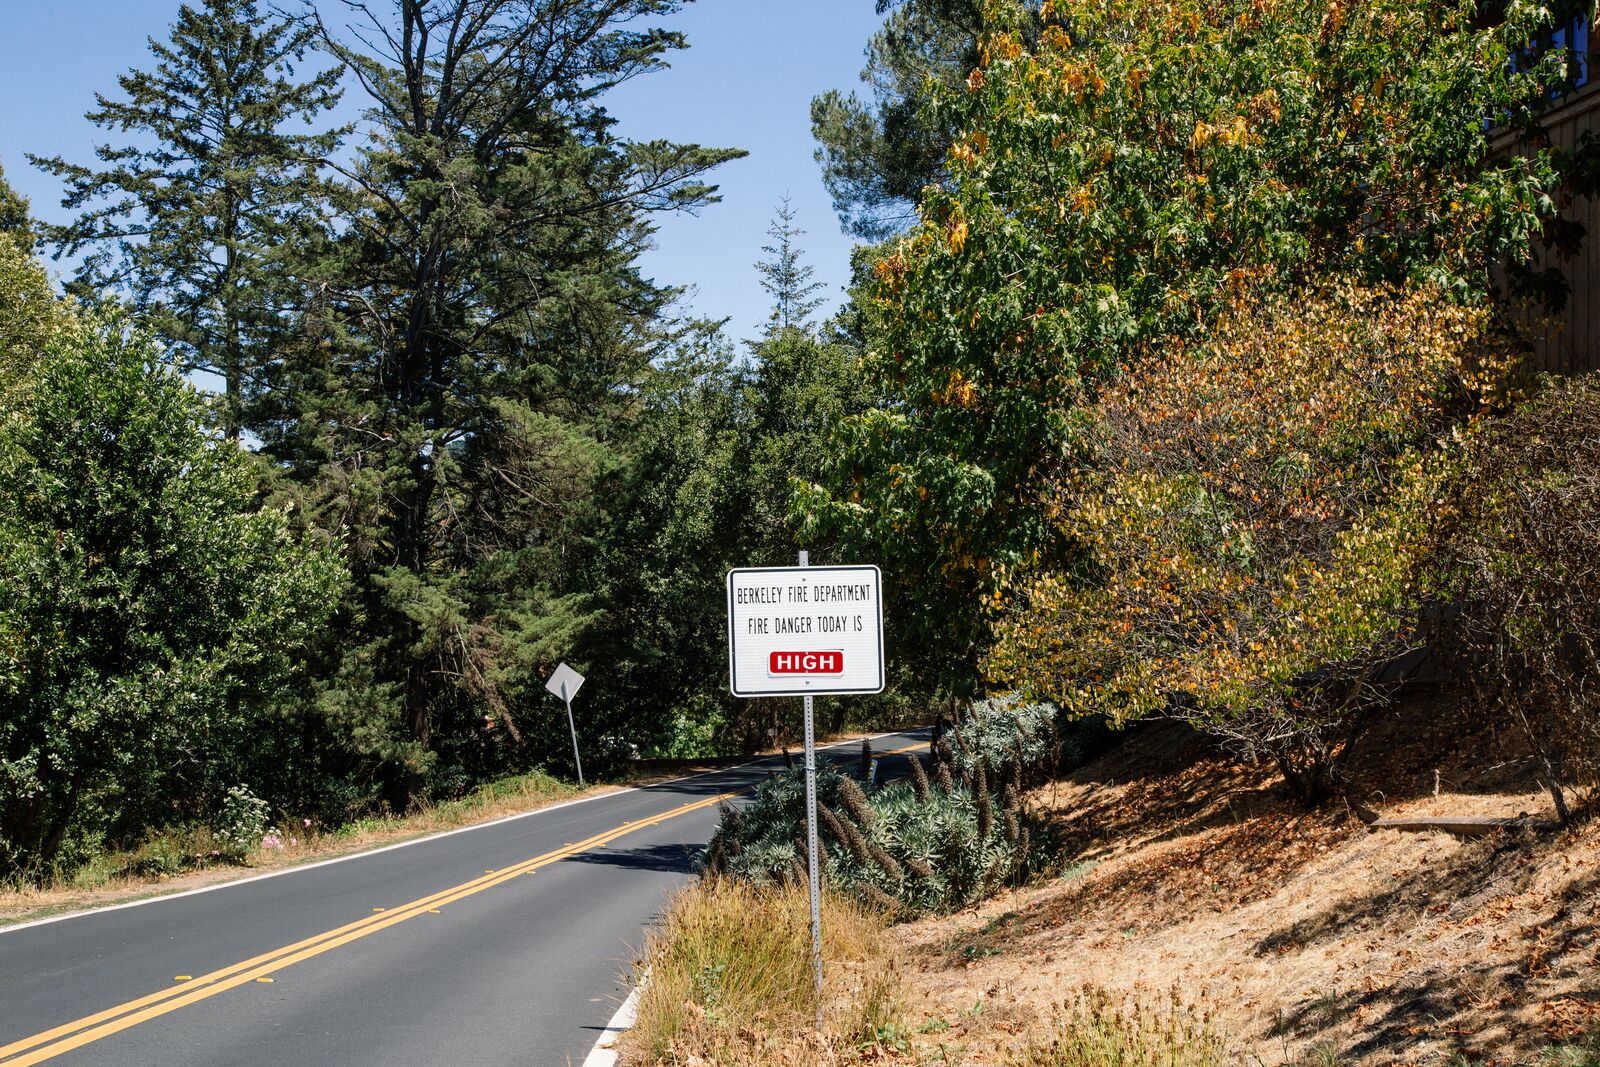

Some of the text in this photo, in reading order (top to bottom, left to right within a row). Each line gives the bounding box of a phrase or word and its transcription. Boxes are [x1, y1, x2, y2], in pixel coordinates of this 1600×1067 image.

[738, 584, 870, 604] BERKELEY FIRE DEPARTMENT
[748, 616, 862, 634] FIRE DANGER TODAY IS
[777, 655, 834, 670] HIGH
